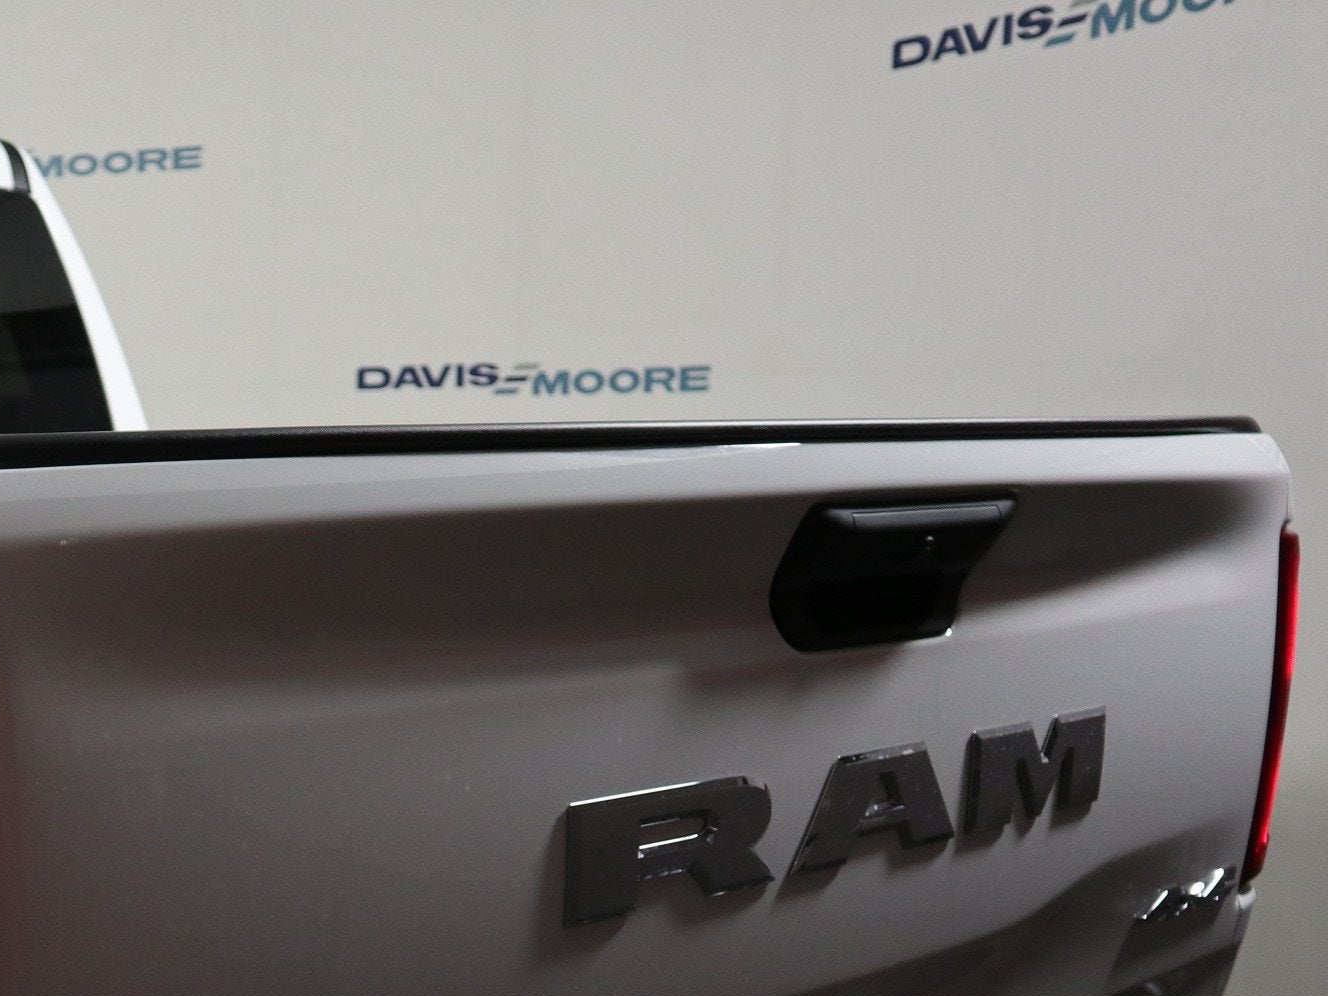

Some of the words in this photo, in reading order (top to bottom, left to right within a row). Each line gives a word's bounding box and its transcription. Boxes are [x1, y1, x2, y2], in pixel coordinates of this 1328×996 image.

[891, 6, 1053, 70] DAVIS
[356, 362, 499, 390] DAVIS
[532, 365, 712, 396] MOORE
[564, 706, 1107, 927] RAM
